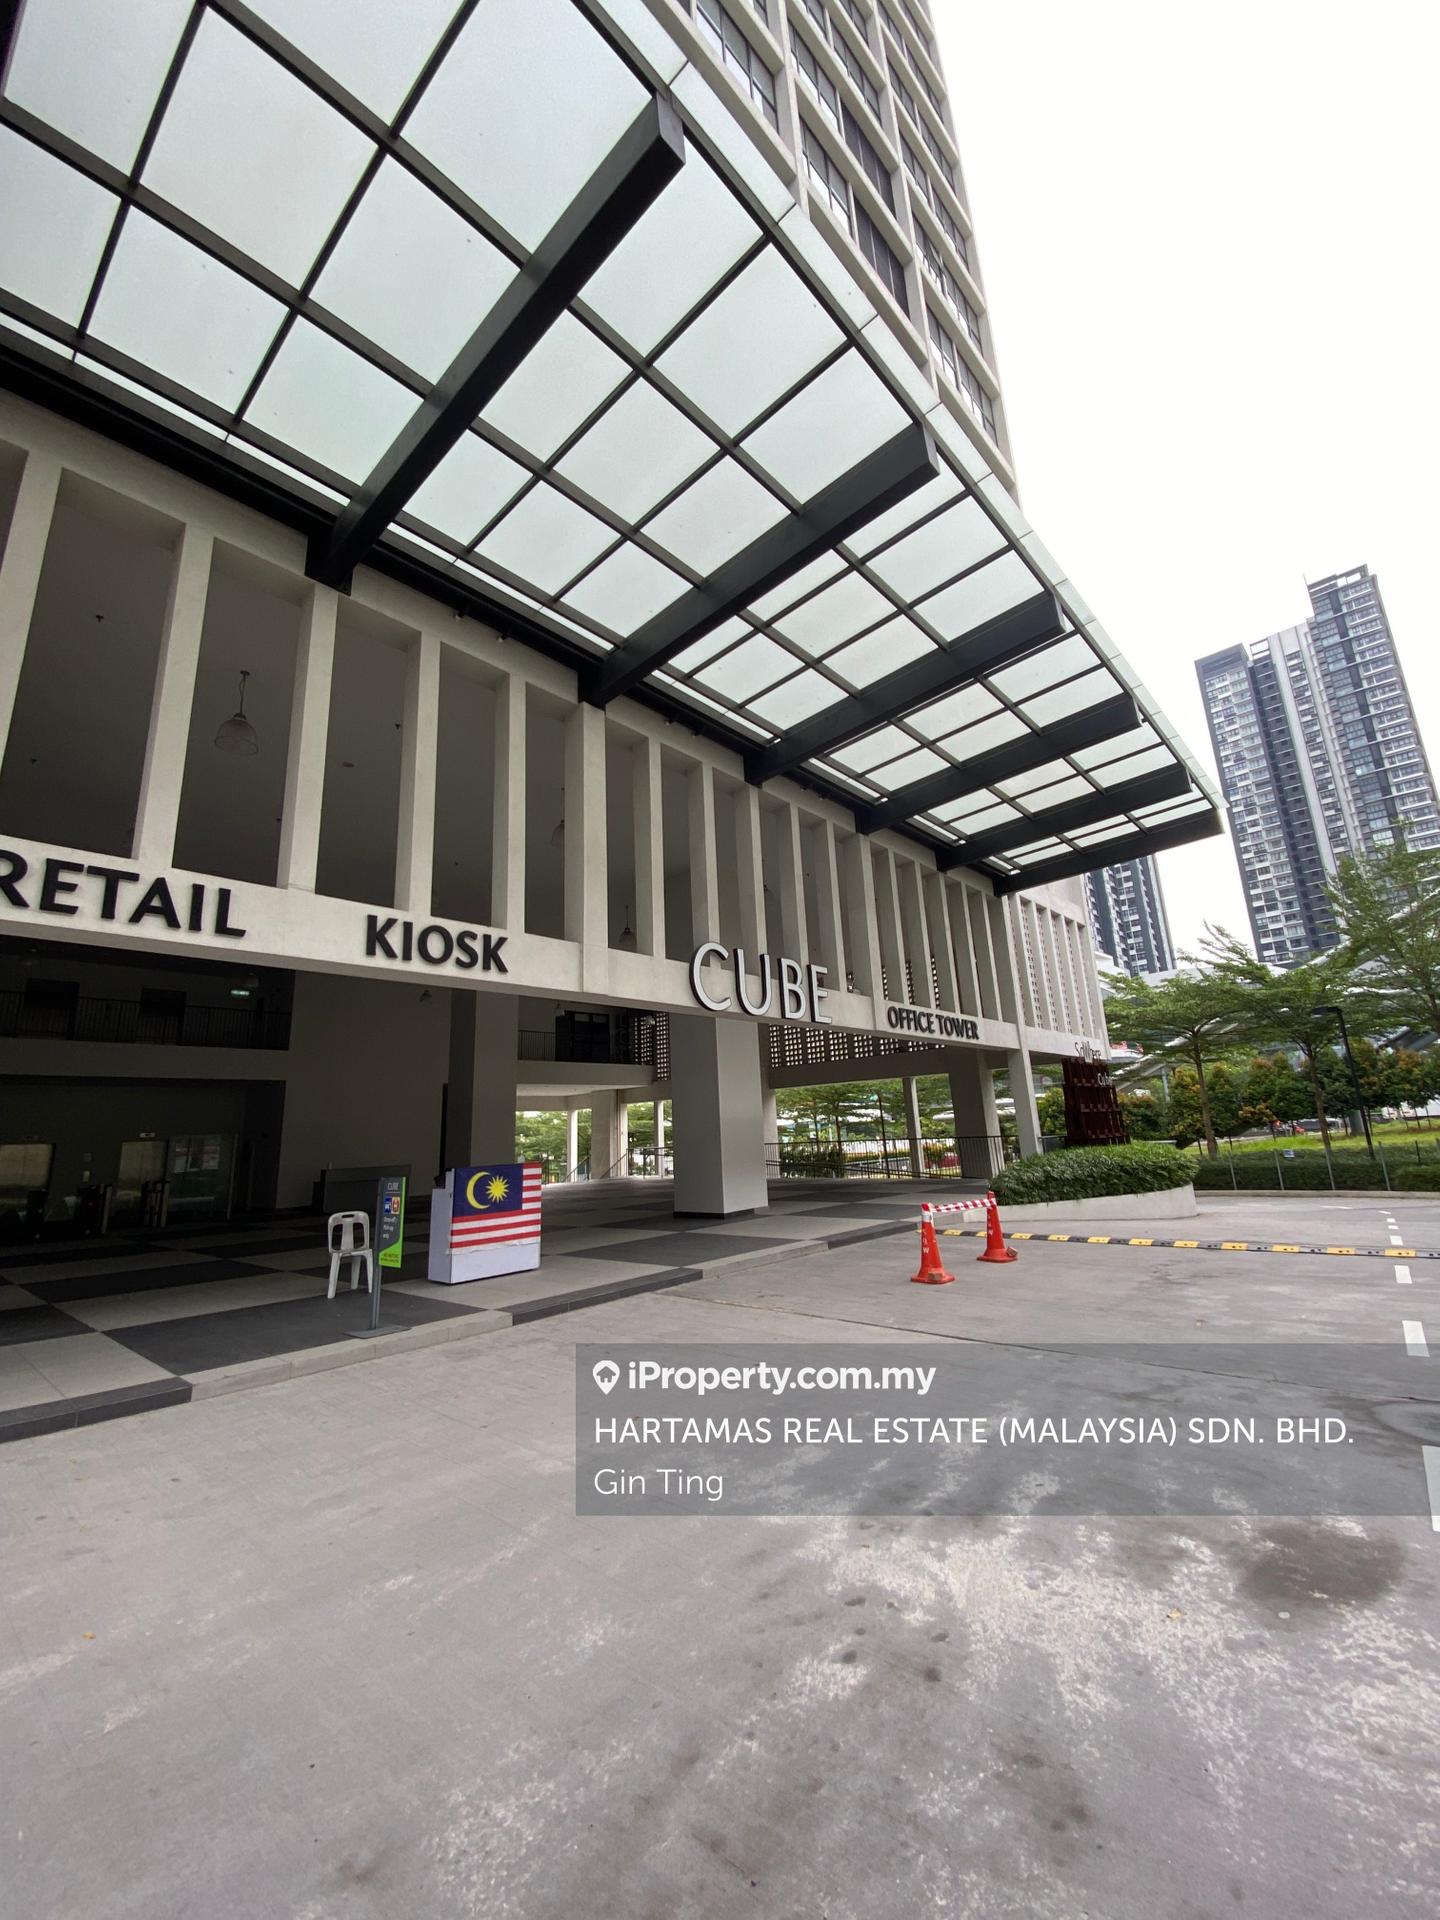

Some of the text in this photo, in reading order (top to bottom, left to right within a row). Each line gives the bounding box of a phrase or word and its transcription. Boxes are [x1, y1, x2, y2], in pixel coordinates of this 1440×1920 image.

[0, 850, 247, 938] RETAIL
[366, 914, 509, 974] KIOSK
[689, 942, 832, 1024] CUBE
[887, 1006, 980, 1041] OFFICE TOWER
